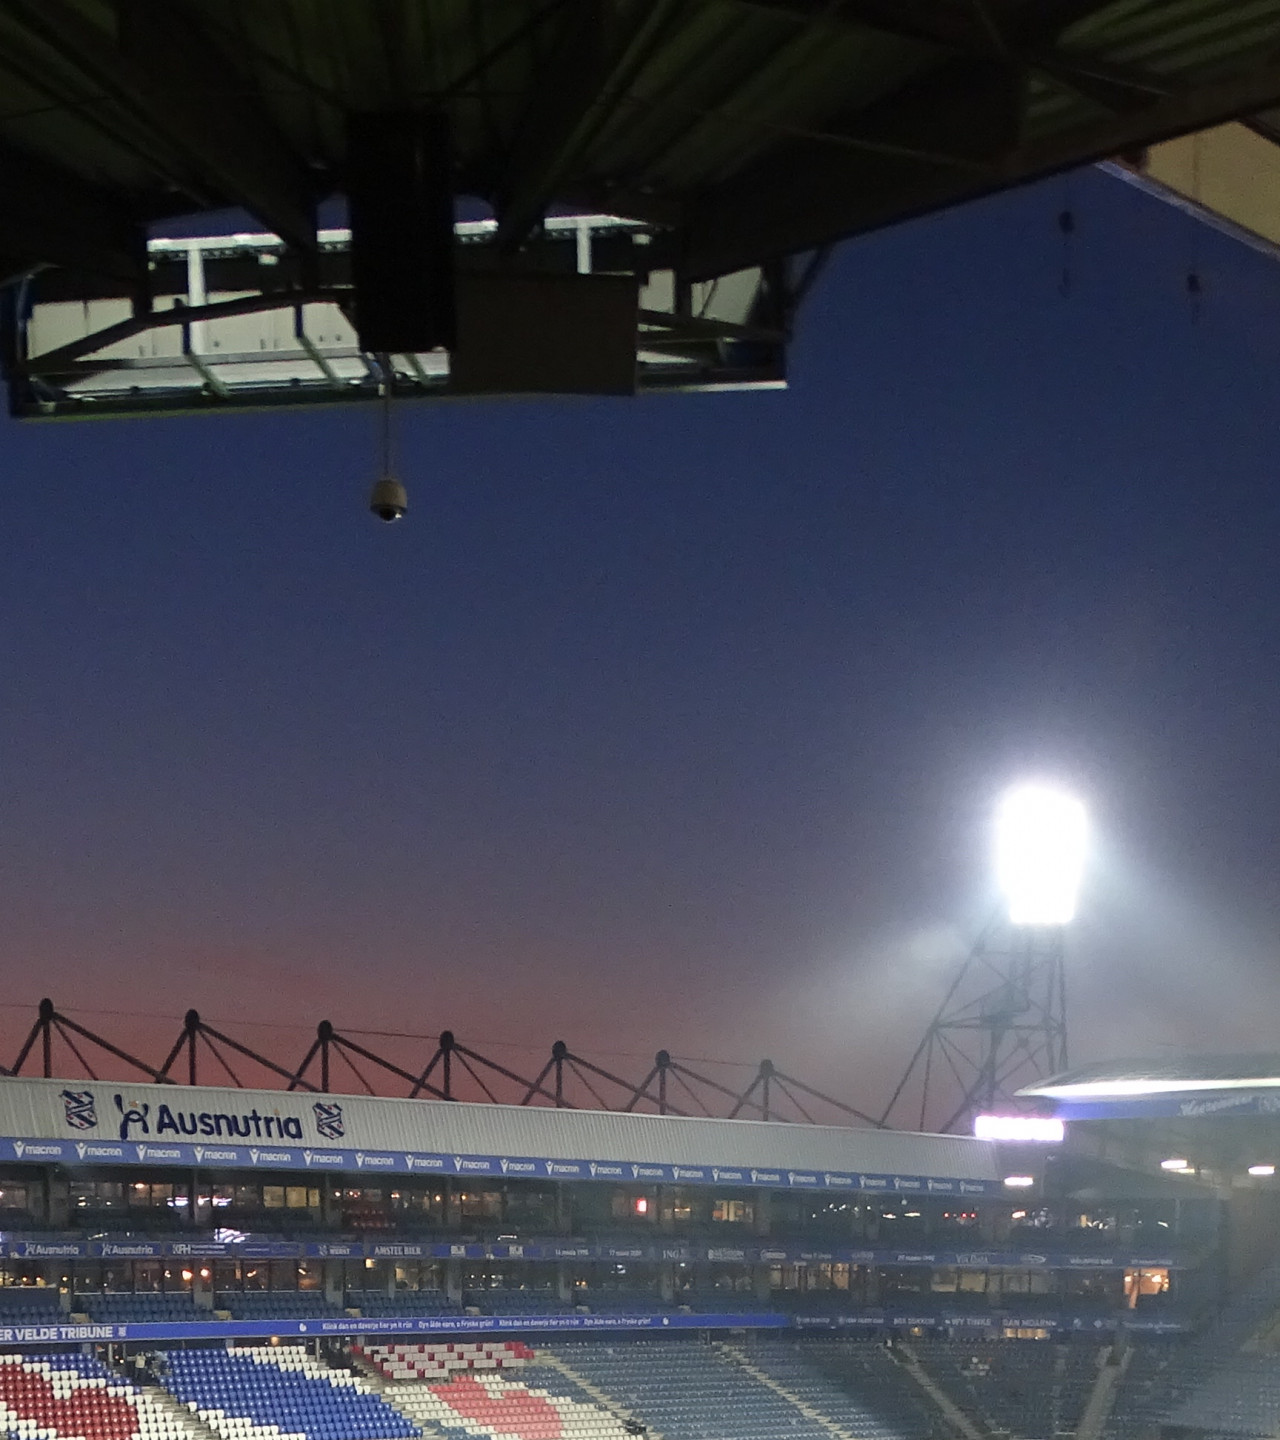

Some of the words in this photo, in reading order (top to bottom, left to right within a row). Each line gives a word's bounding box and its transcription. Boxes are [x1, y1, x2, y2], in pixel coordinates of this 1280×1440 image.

[157, 1104, 303, 1139] Ausnutria
[24, 1144, 61, 1155] macron
[87, 1146, 122, 1157] macron
[147, 1147, 181, 1158] macron
[204, 1149, 237, 1160] macron
[259, 1151, 291, 1162] macron
[312, 1153, 343, 1164] macron
[364, 1155, 394, 1166] macron
[414, 1157, 443, 1168] macron
[462, 1159, 490, 1170] macron
[508, 1161, 535, 1172] macron
[553, 1163, 580, 1173] macron
[597, 1165, 623, 1175] macron
[639, 1167, 664, 1177] macron
[679, 1169, 703, 1179] macron
[36, 1244, 79, 1255] Ausnutria
[111, 1245, 153, 1255] Ausnutria
[14, 1328, 58, 1340] VELDE
[59, 1326, 112, 1340] TRIBUNE
